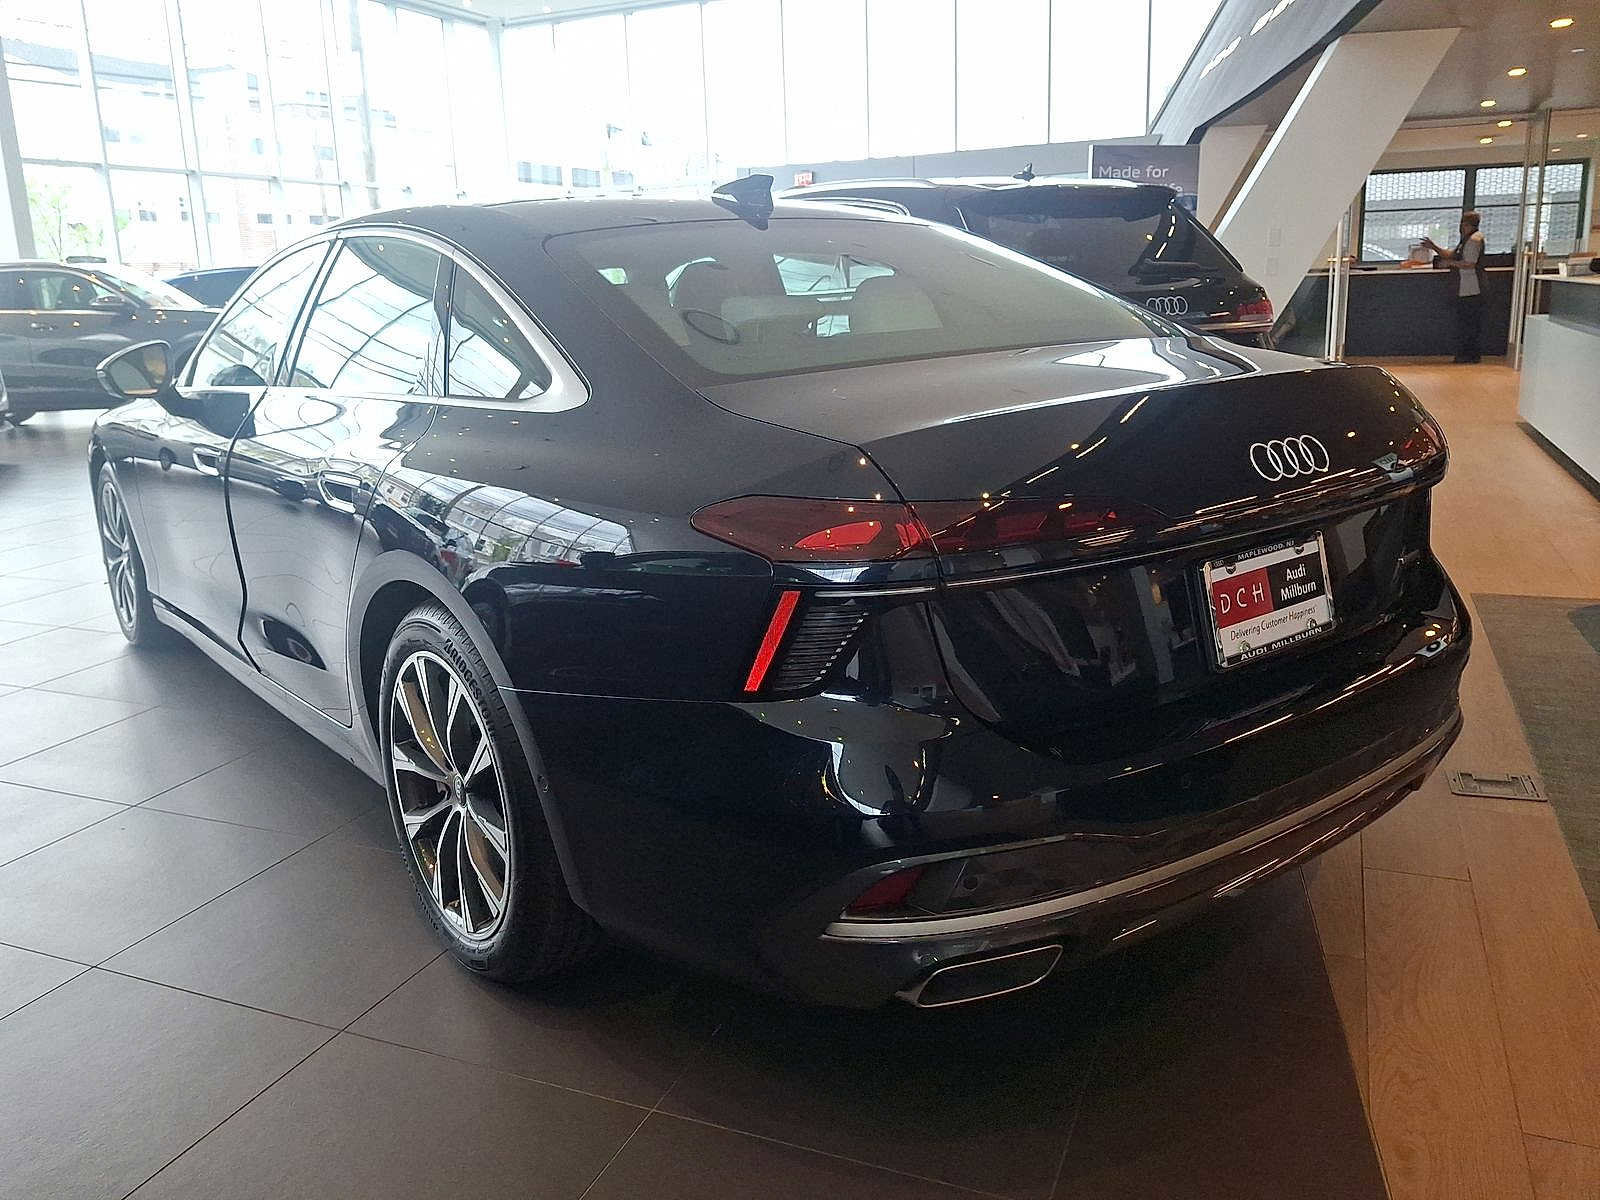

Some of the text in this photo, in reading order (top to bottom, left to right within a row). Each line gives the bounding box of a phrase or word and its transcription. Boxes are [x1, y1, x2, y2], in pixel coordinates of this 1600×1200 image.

[1098, 165, 1169, 179] Made for
[1286, 563, 1307, 581] Audi
[1280, 580, 1317, 601] Millburn
[1231, 606, 1316, 640] Delivering Customer Happiness
[1240, 626, 1322, 660] AUDI MILLBURN
